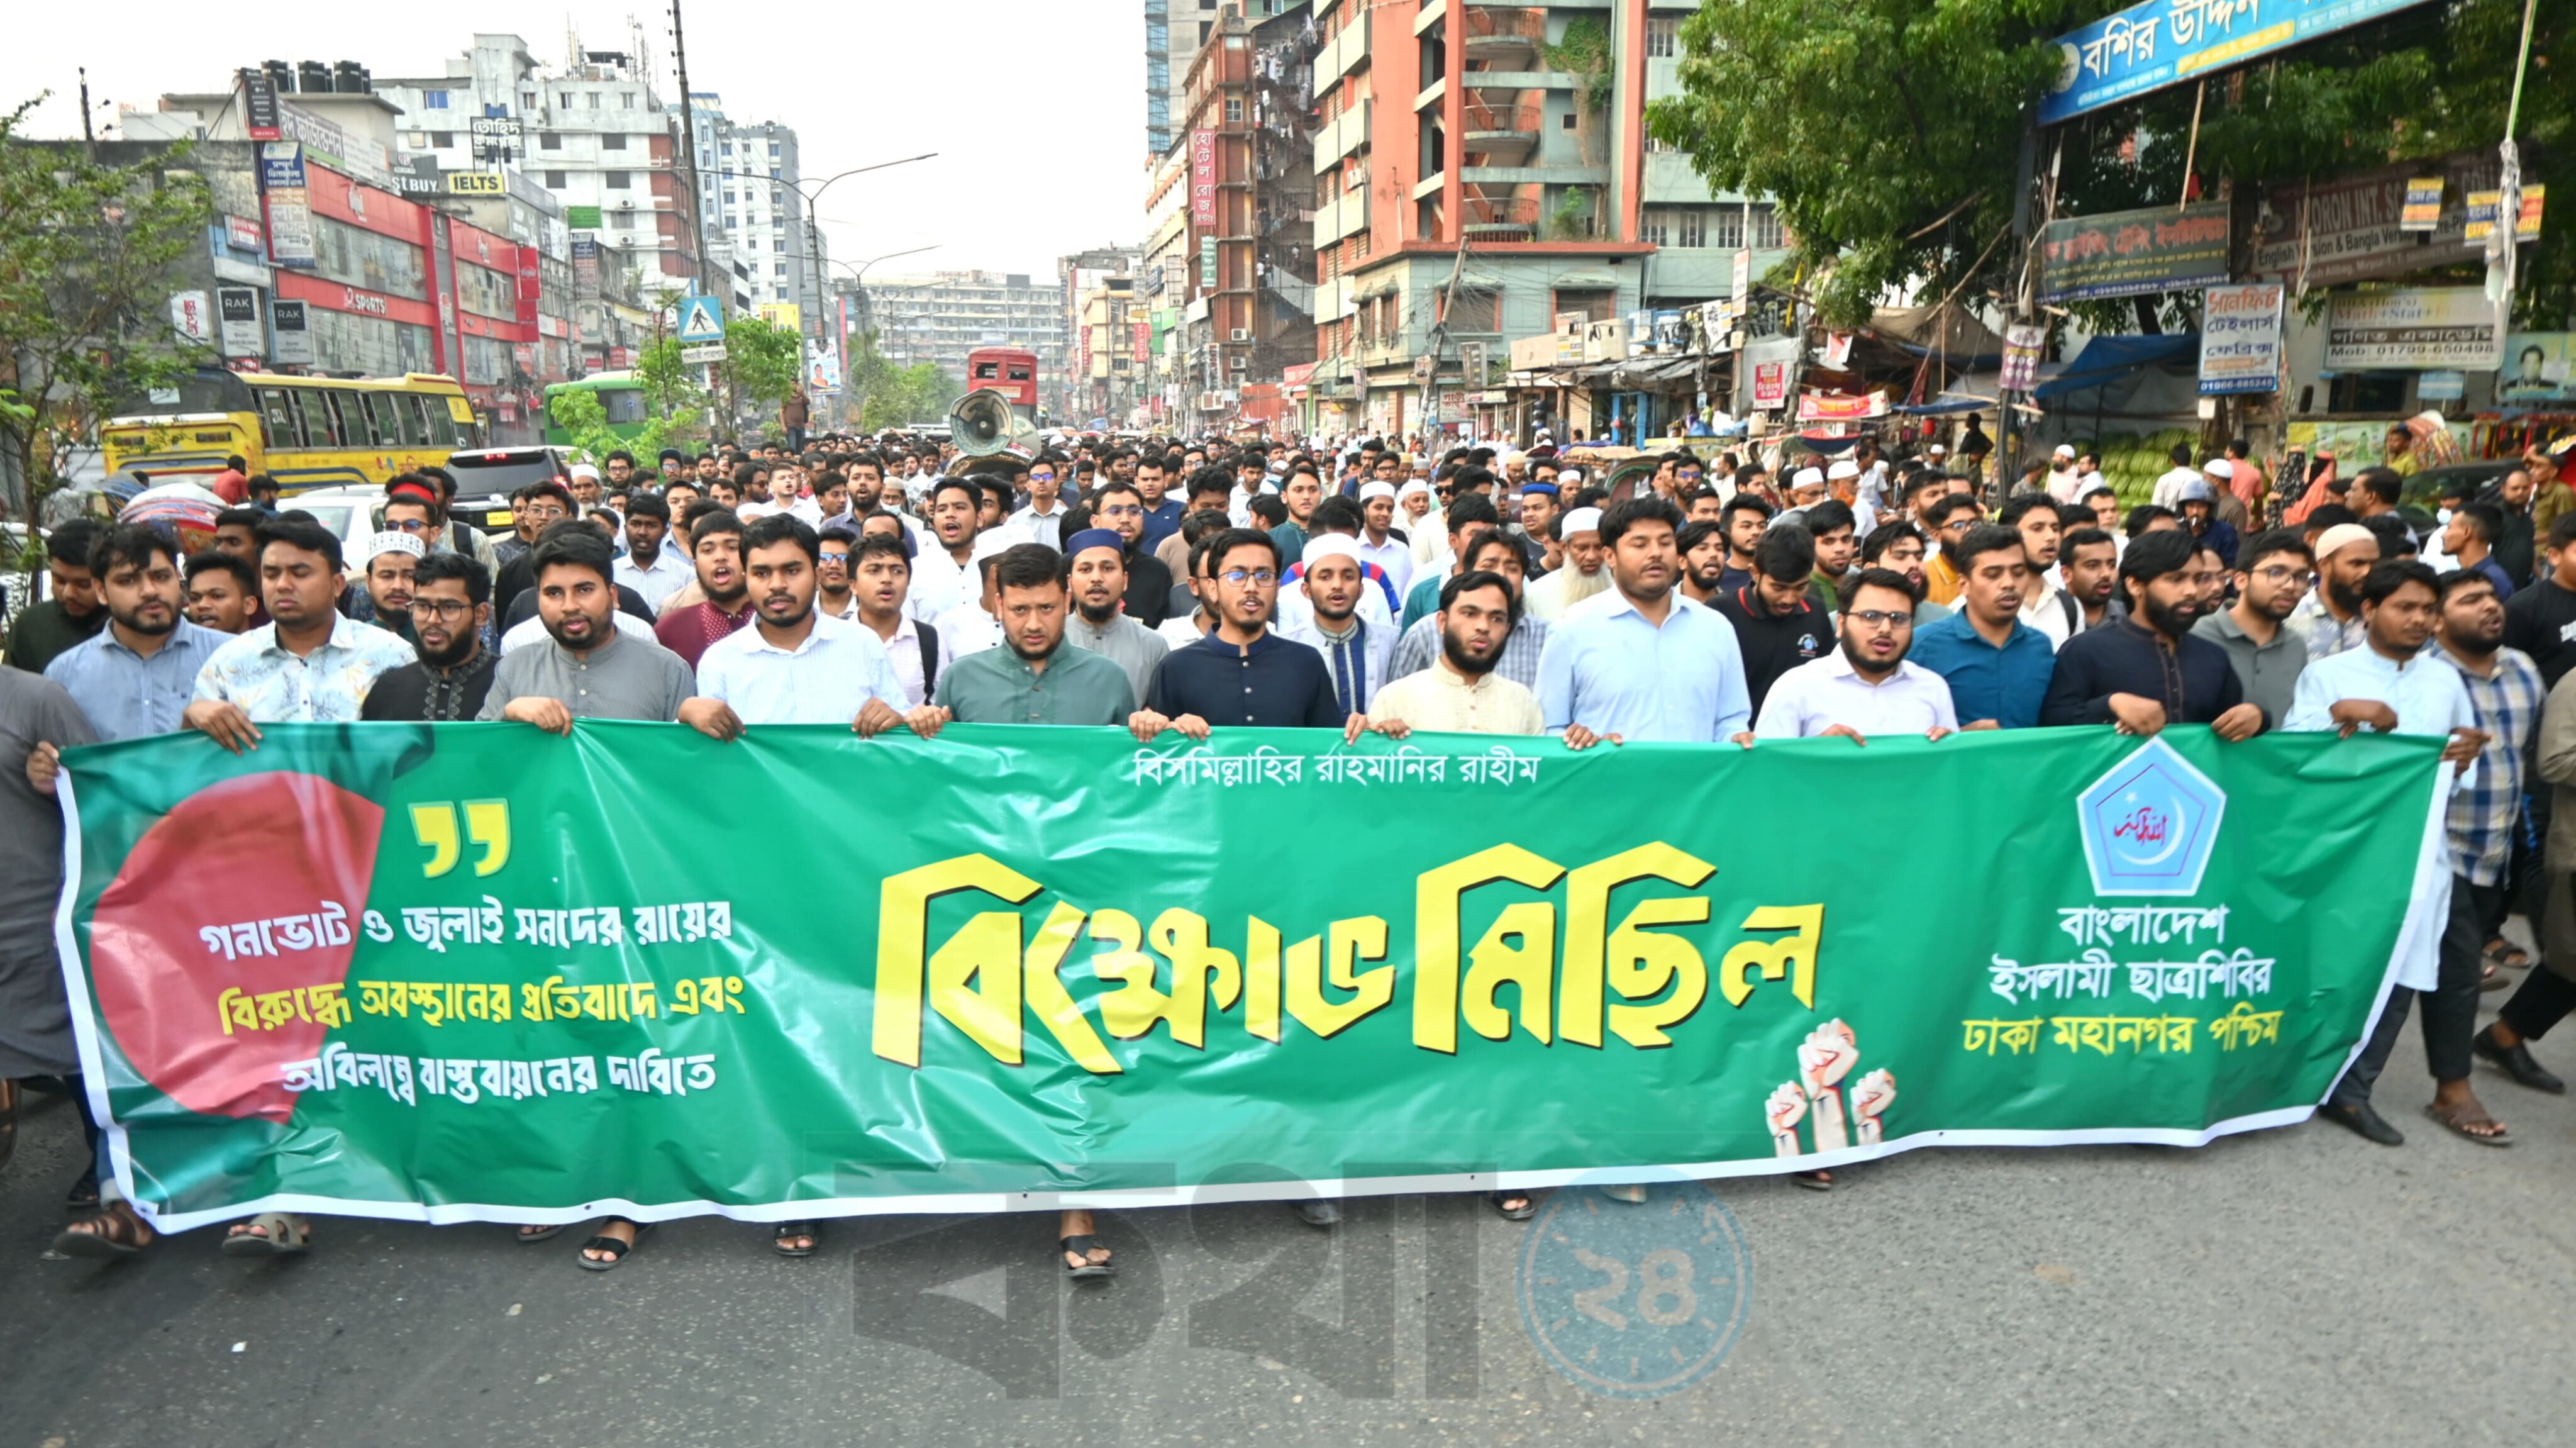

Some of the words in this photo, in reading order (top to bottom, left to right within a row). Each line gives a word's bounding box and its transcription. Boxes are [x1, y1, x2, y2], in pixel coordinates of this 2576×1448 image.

[2082, 17, 2161, 79] বশির
[409, 179, 438, 193] BUY
[453, 175, 499, 191] IELTS
[2258, 244, 2294, 268] English
[2345, 230, 2380, 252] Bangla
[225, 298, 250, 308] RAK
[277, 309, 301, 319] RAK
[355, 292, 387, 315] SPORTS
[1133, 745, 1305, 788] বিসমিল্লাহির
[1314, 745, 1449, 787] রাহমানির
[1458, 745, 1542, 786] রাহীম
[199, 900, 352, 961] গনভোট
[362, 910, 394, 943] ও
[400, 894, 504, 954] জুলাই
[513, 907, 622, 949] সনদের
[632, 901, 732, 945] রায়ের
[2057, 903, 2230, 947] বাংলাদেশ
[872, 852, 1396, 1076] বিক্ষোভ
[1412, 840, 1824, 1055] মিছিল
[1988, 947, 2118, 1005] ইসলামী
[2125, 947, 2277, 1003] ছাত্রশিবির
[218, 981, 352, 1035] বিরুদ্ধে
[358, 981, 512, 1027] অবস্থানের
[521, 975, 657, 1023] প্রতিবাদে
[669, 976, 746, 1016] এবং
[1961, 1013, 2045, 1056] ঢাকা
[2050, 1013, 2199, 1056] মহানগর
[2208, 1001, 2284, 1052] পশ্চিম
[279, 1041, 416, 1107] অবিলম্বে
[418, 1055, 599, 1105] বাস্তবায়নের
[606, 1047, 716, 1097] দাবিতে
